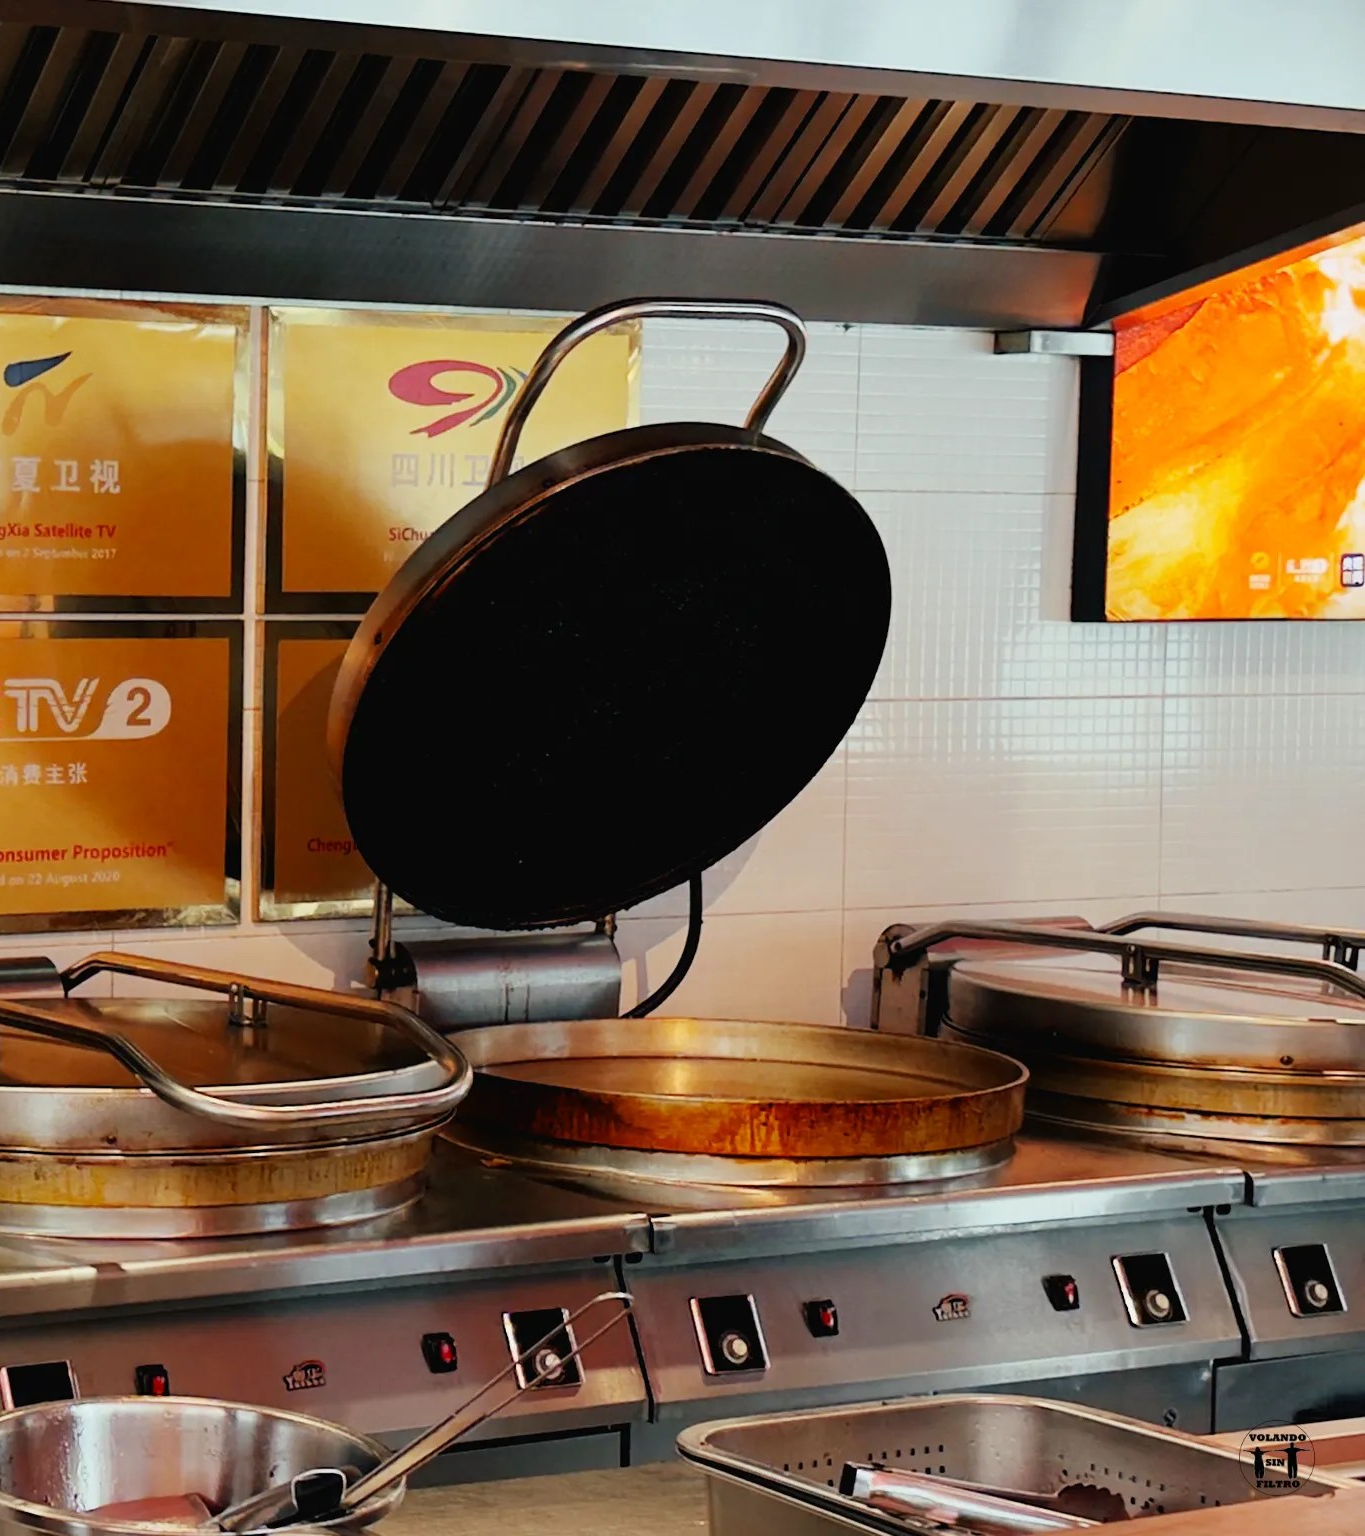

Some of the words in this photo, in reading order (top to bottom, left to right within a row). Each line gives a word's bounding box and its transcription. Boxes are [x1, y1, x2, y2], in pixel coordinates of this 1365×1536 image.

[35, 523, 92, 539] Satellite
[96, 524, 116, 538] TV
[91, 548, 117, 559] 2017
[126, 687, 152, 726] 2
[0, 762, 88, 786] 消费主张
[45, 873, 88, 887] August
[91, 871, 120, 883] 2020
